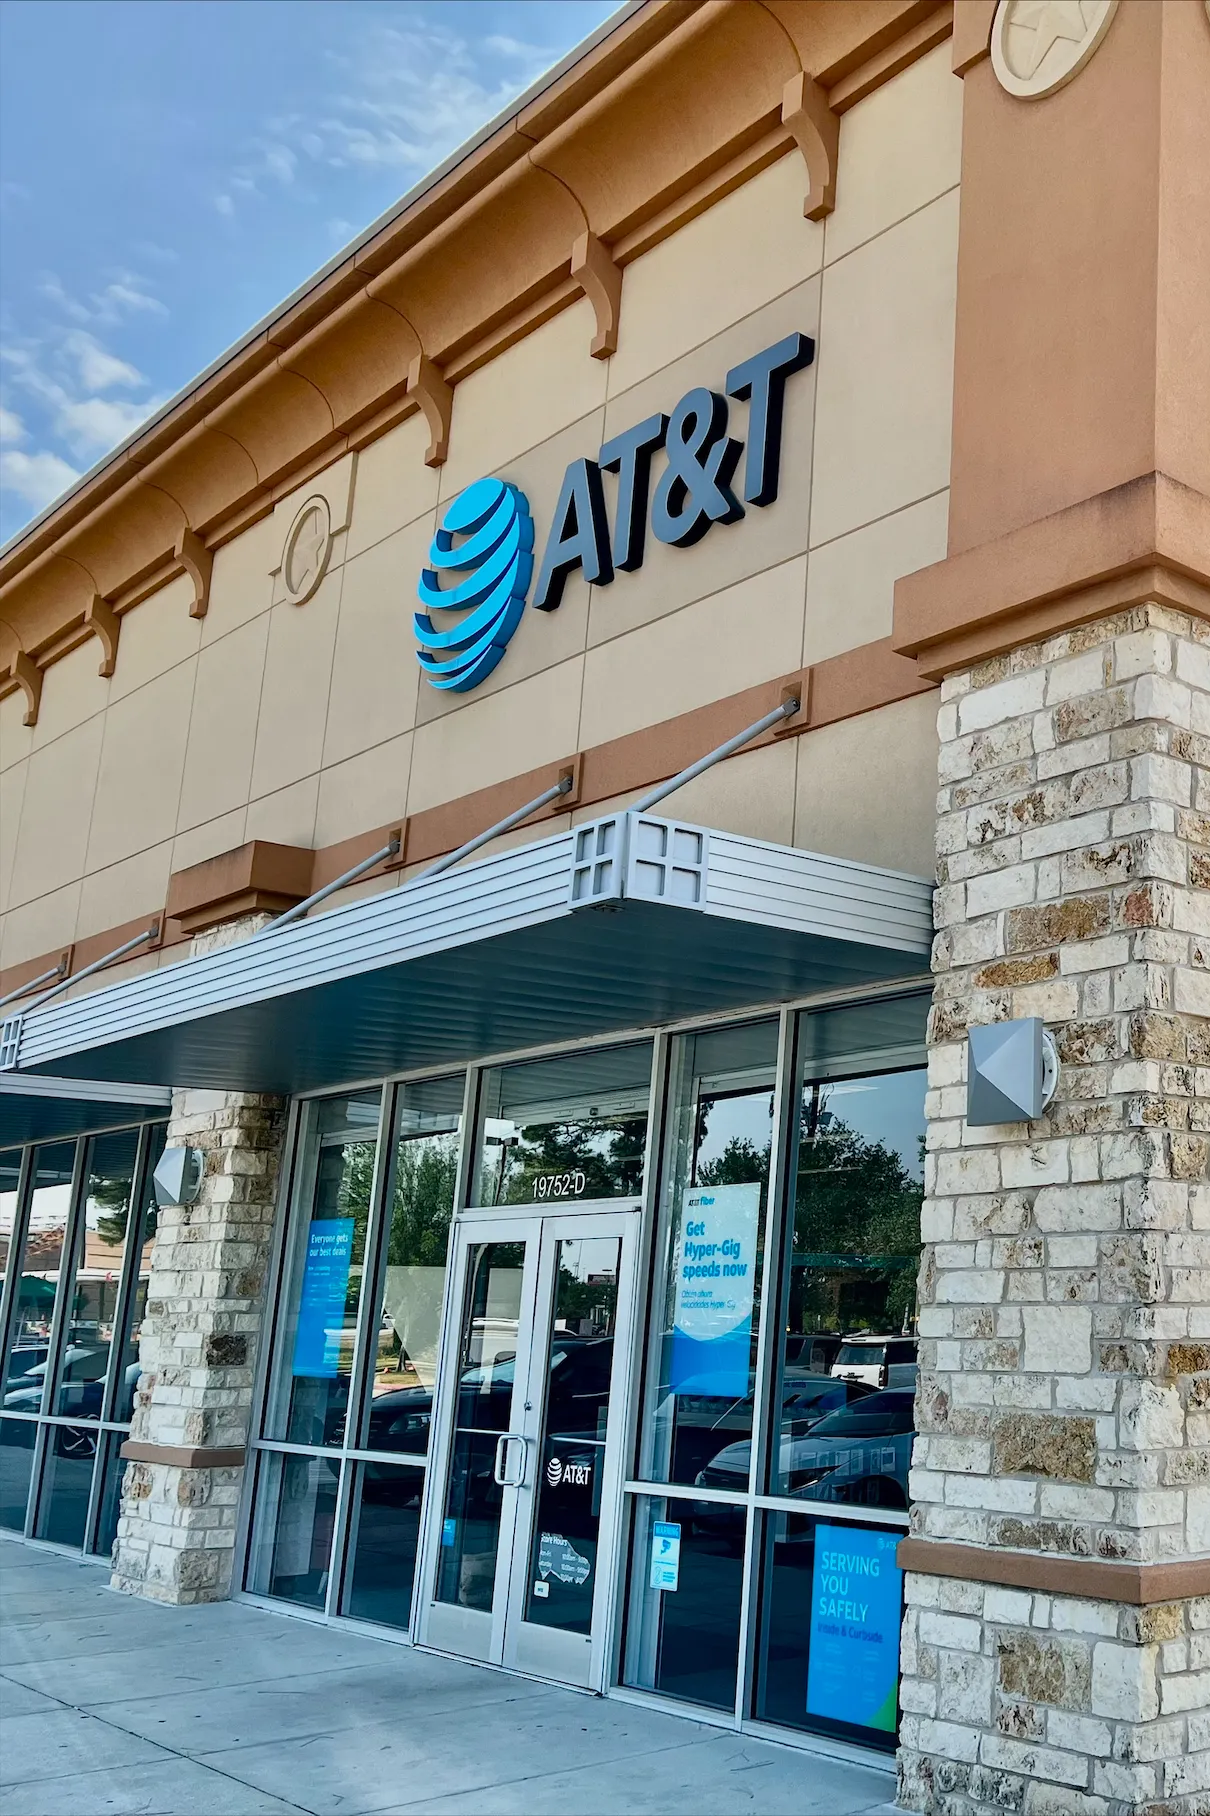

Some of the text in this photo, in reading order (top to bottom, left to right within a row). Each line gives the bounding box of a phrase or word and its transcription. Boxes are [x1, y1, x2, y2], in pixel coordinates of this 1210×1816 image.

[532, 331, 815, 612] AT&T
[531, 1172, 586, 1198] 19752-D
[700, 1196, 715, 1206] fiber
[311, 1233, 349, 1246] Everyone gets
[686, 1221, 705, 1237] Get
[309, 1245, 347, 1257] our best deals
[684, 1239, 741, 1261] Hyper-Gig
[682, 1260, 748, 1282] speeds now
[562, 1464, 591, 1485] AT&T
[885, 1540, 896, 1550] AT&
[821, 1550, 880, 1577] SERVING
[820, 1573, 849, 1596] YOU
[818, 1596, 869, 1622] SAFELY
[848, 1627, 884, 1644] Curbside
